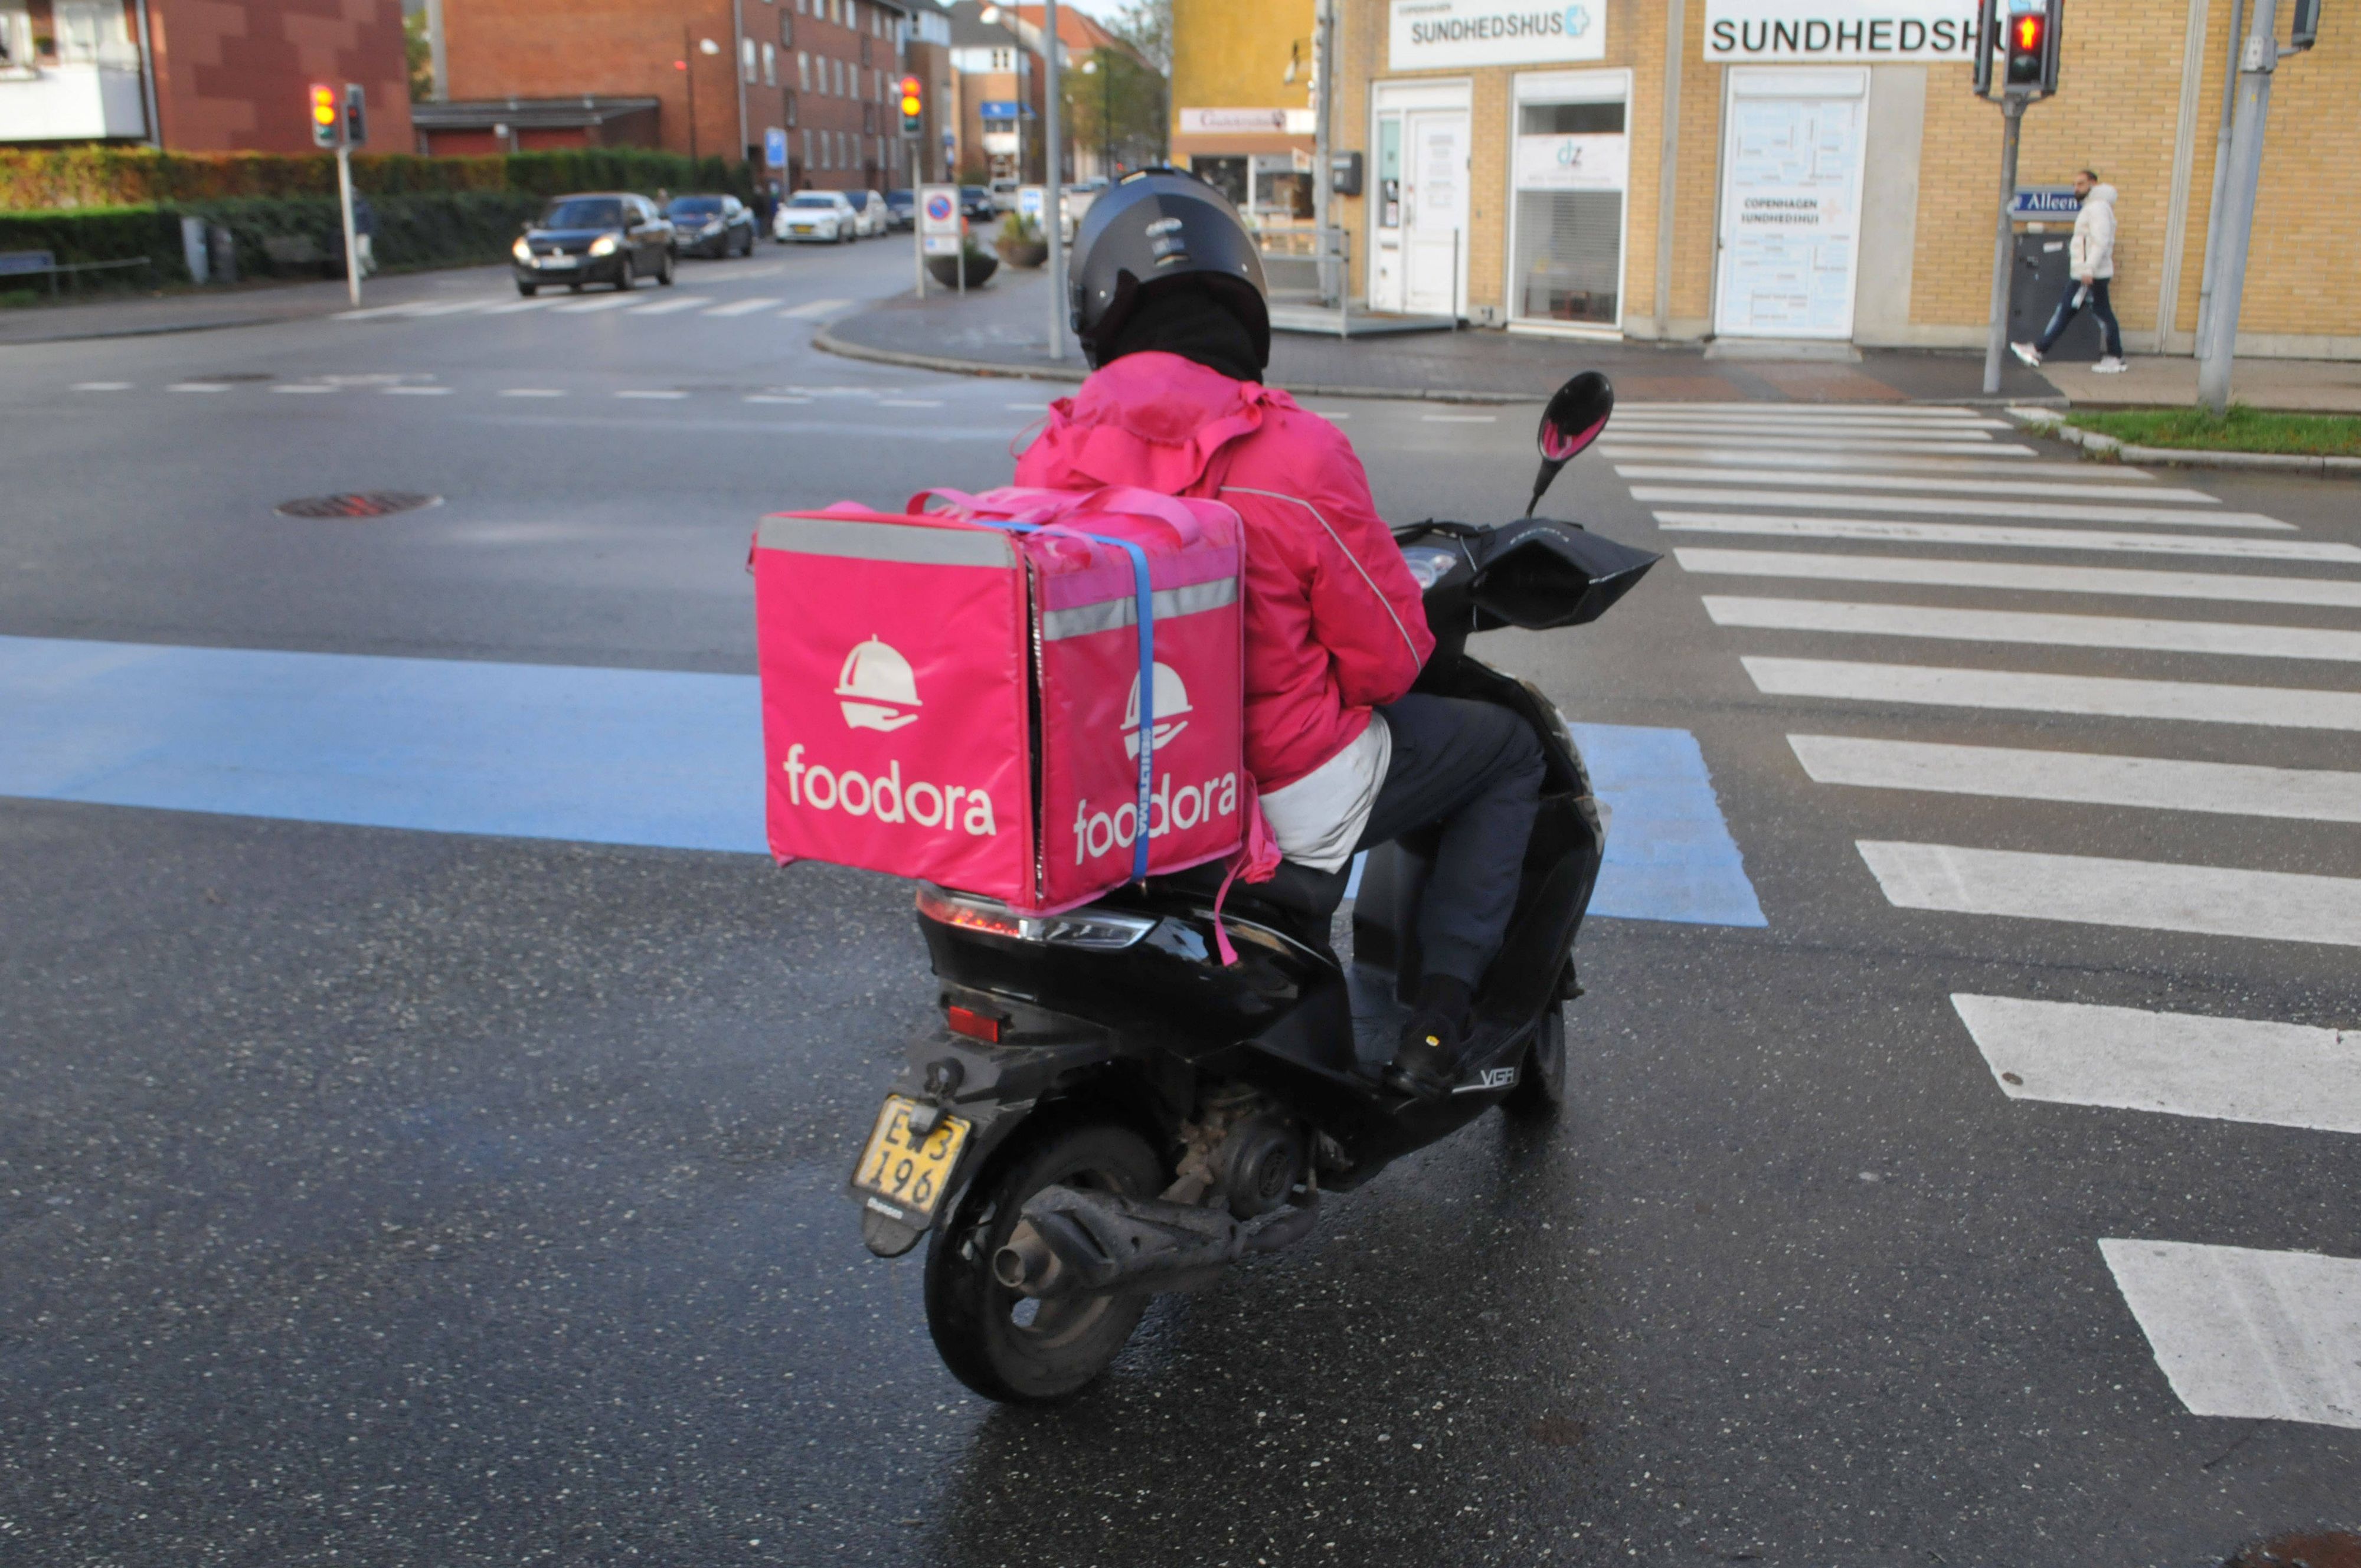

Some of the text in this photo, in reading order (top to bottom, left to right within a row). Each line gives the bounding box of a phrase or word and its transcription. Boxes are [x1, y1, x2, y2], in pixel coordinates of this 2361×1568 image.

[1412, 12, 1562, 44] SUNDHEDSHUS
[1744, 198, 1819, 209] COPENHAGEN
[783, 743, 996, 836] foodora
[1074, 771, 1236, 866] foodora
[1137, 740, 1151, 837] BILTEMA
[870, 1151, 934, 1203] 196
